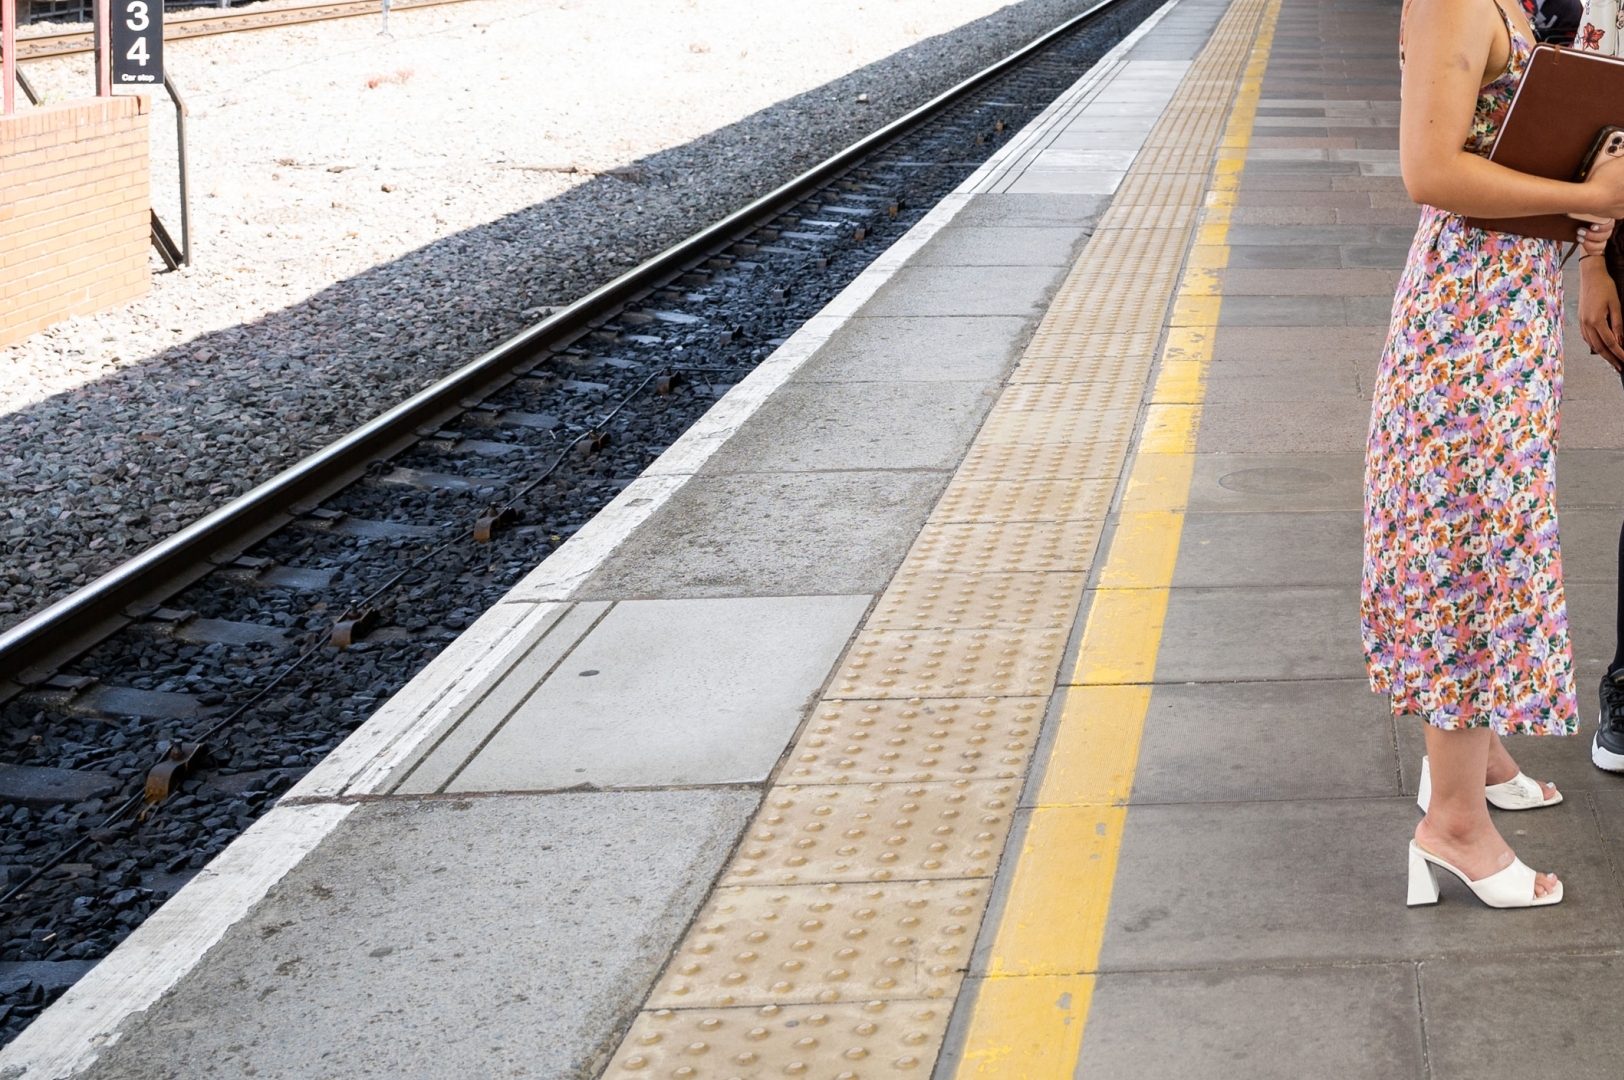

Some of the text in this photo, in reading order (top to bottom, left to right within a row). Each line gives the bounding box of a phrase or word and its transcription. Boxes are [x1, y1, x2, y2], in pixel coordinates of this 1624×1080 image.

[126, 0, 150, 31] 3
[126, 36, 150, 66] 4
[121, 73, 155, 83] Car stop
